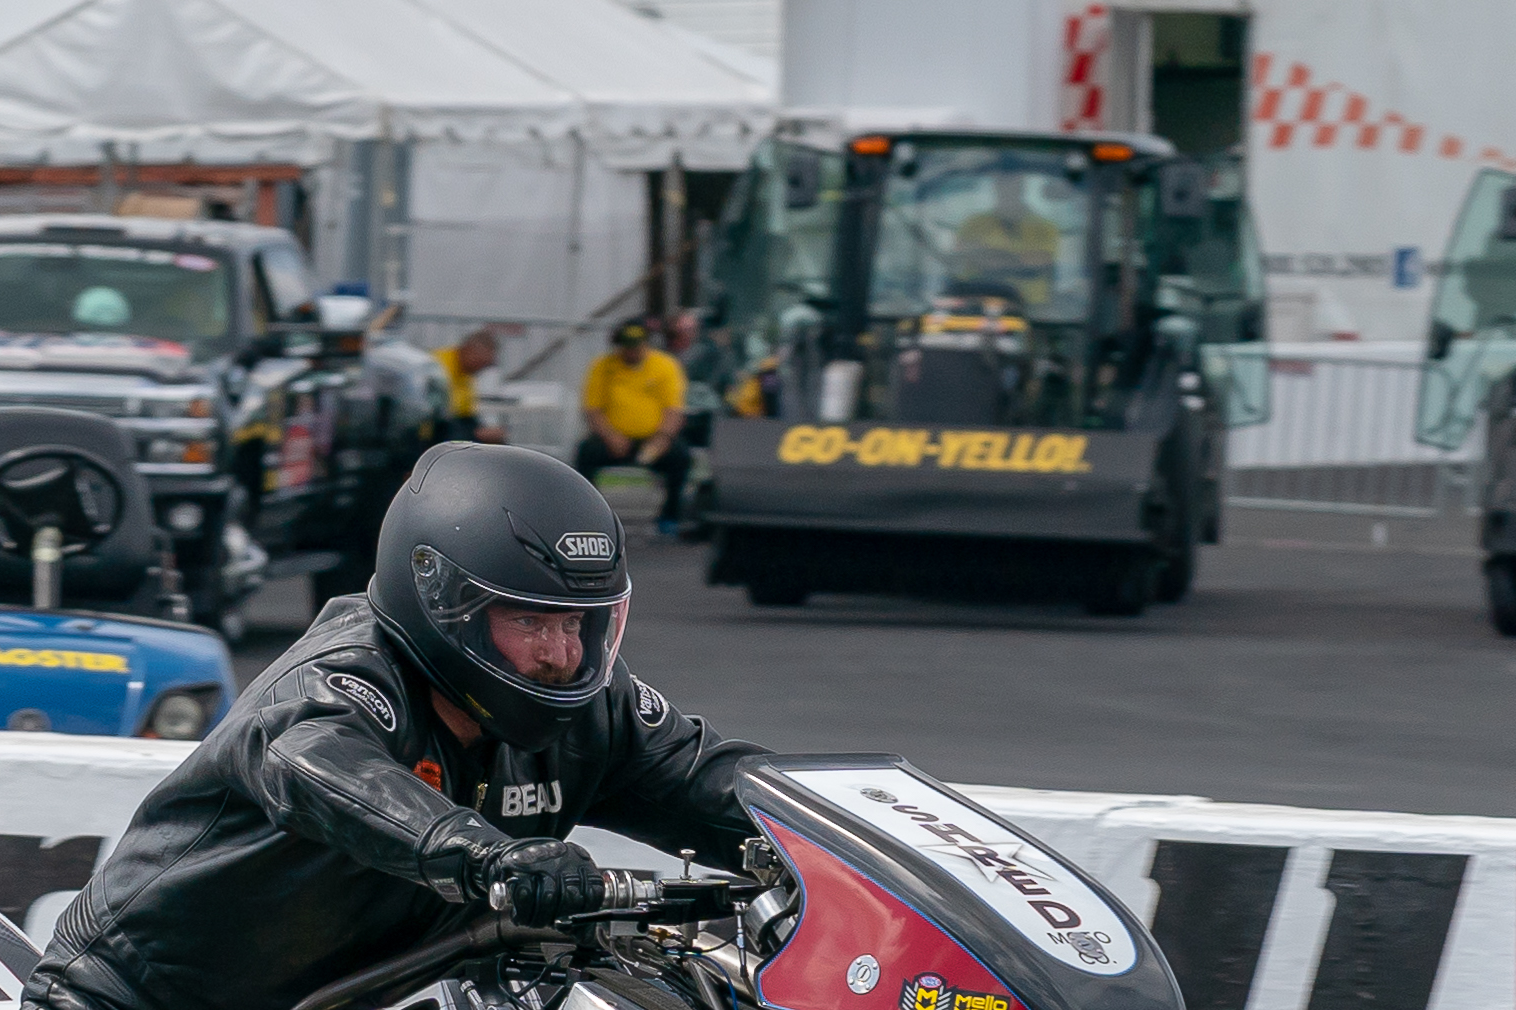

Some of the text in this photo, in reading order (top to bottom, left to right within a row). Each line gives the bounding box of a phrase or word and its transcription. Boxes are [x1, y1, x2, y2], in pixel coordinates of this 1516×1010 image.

[565, 537, 610, 556] SHOEI
[341, 677, 392, 720] vanson
[502, 780, 562, 816] BEAU
[892, 804, 1082, 930] SHRED
